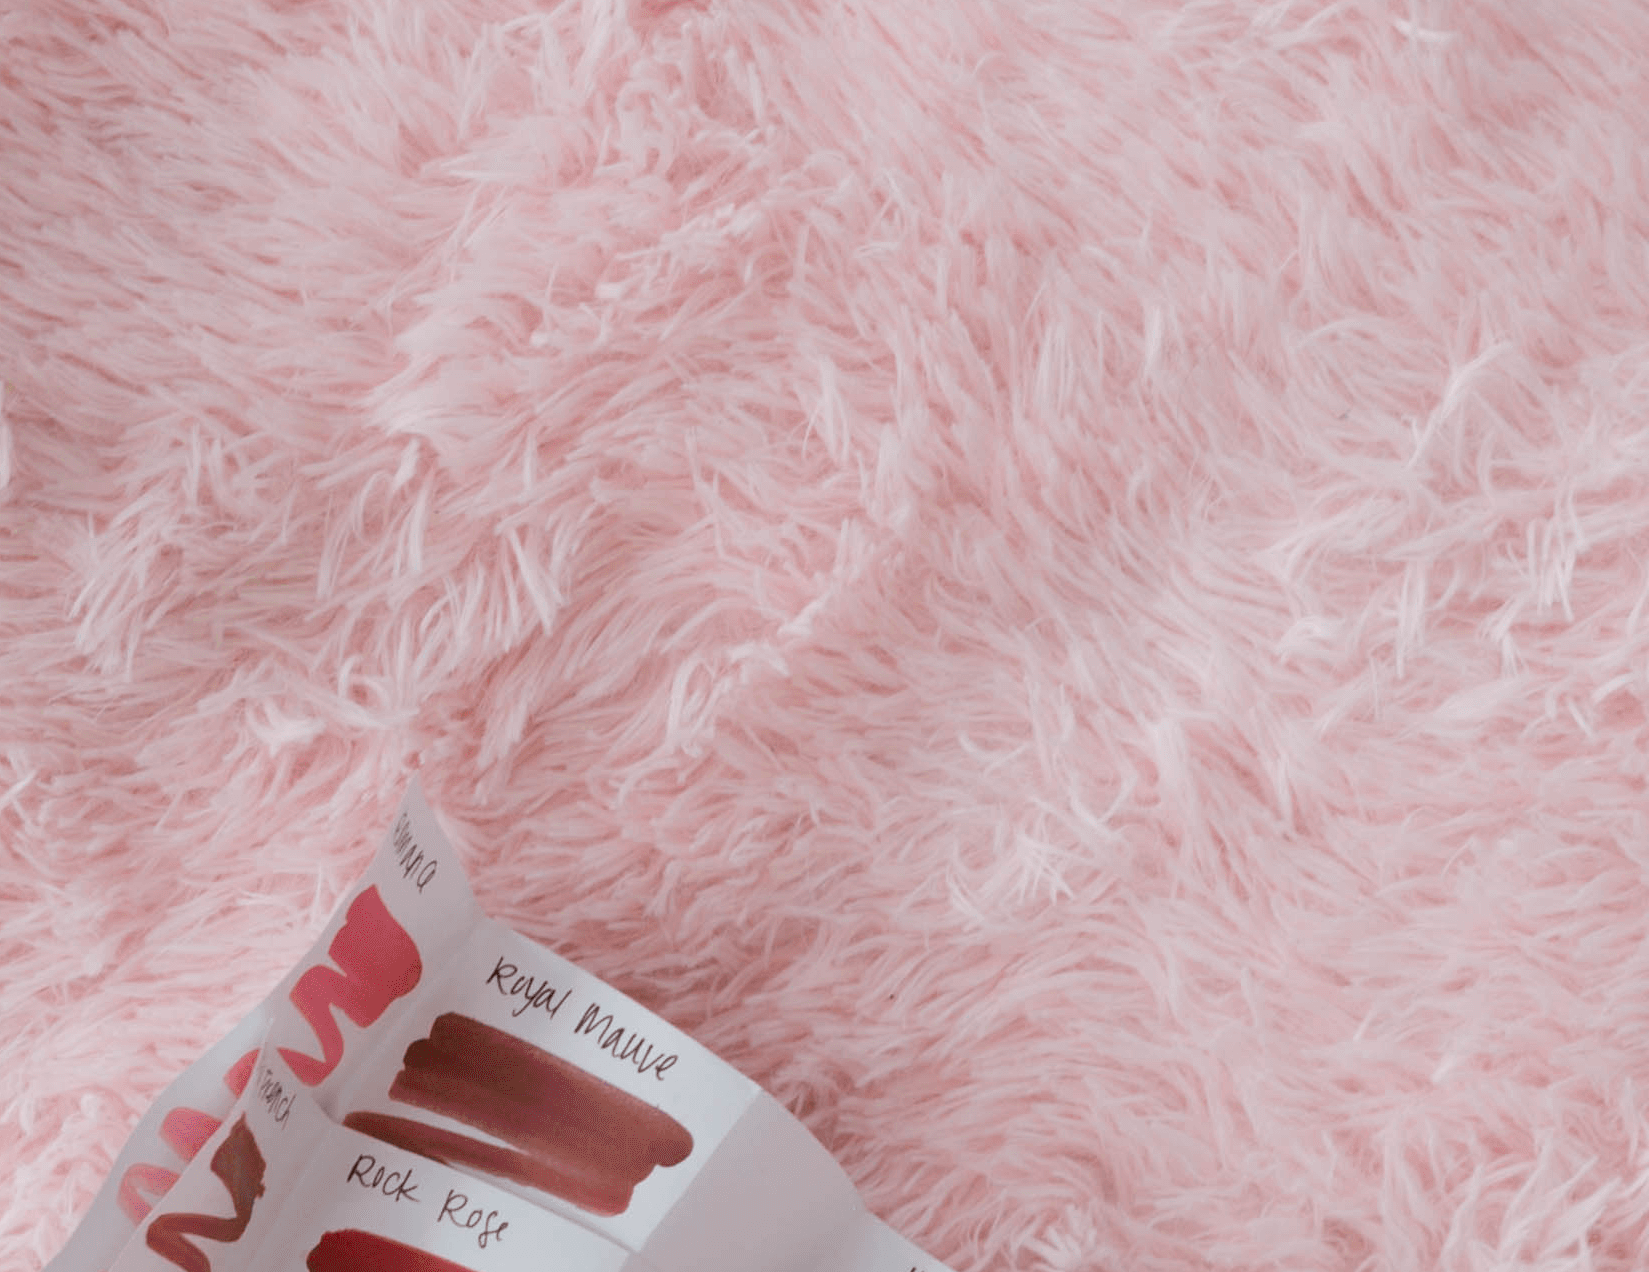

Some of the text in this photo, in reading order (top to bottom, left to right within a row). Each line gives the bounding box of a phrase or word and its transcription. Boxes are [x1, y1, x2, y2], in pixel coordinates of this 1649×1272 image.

[485, 956, 573, 1020] Royal
[346, 1154, 509, 1249] Rock Rose
